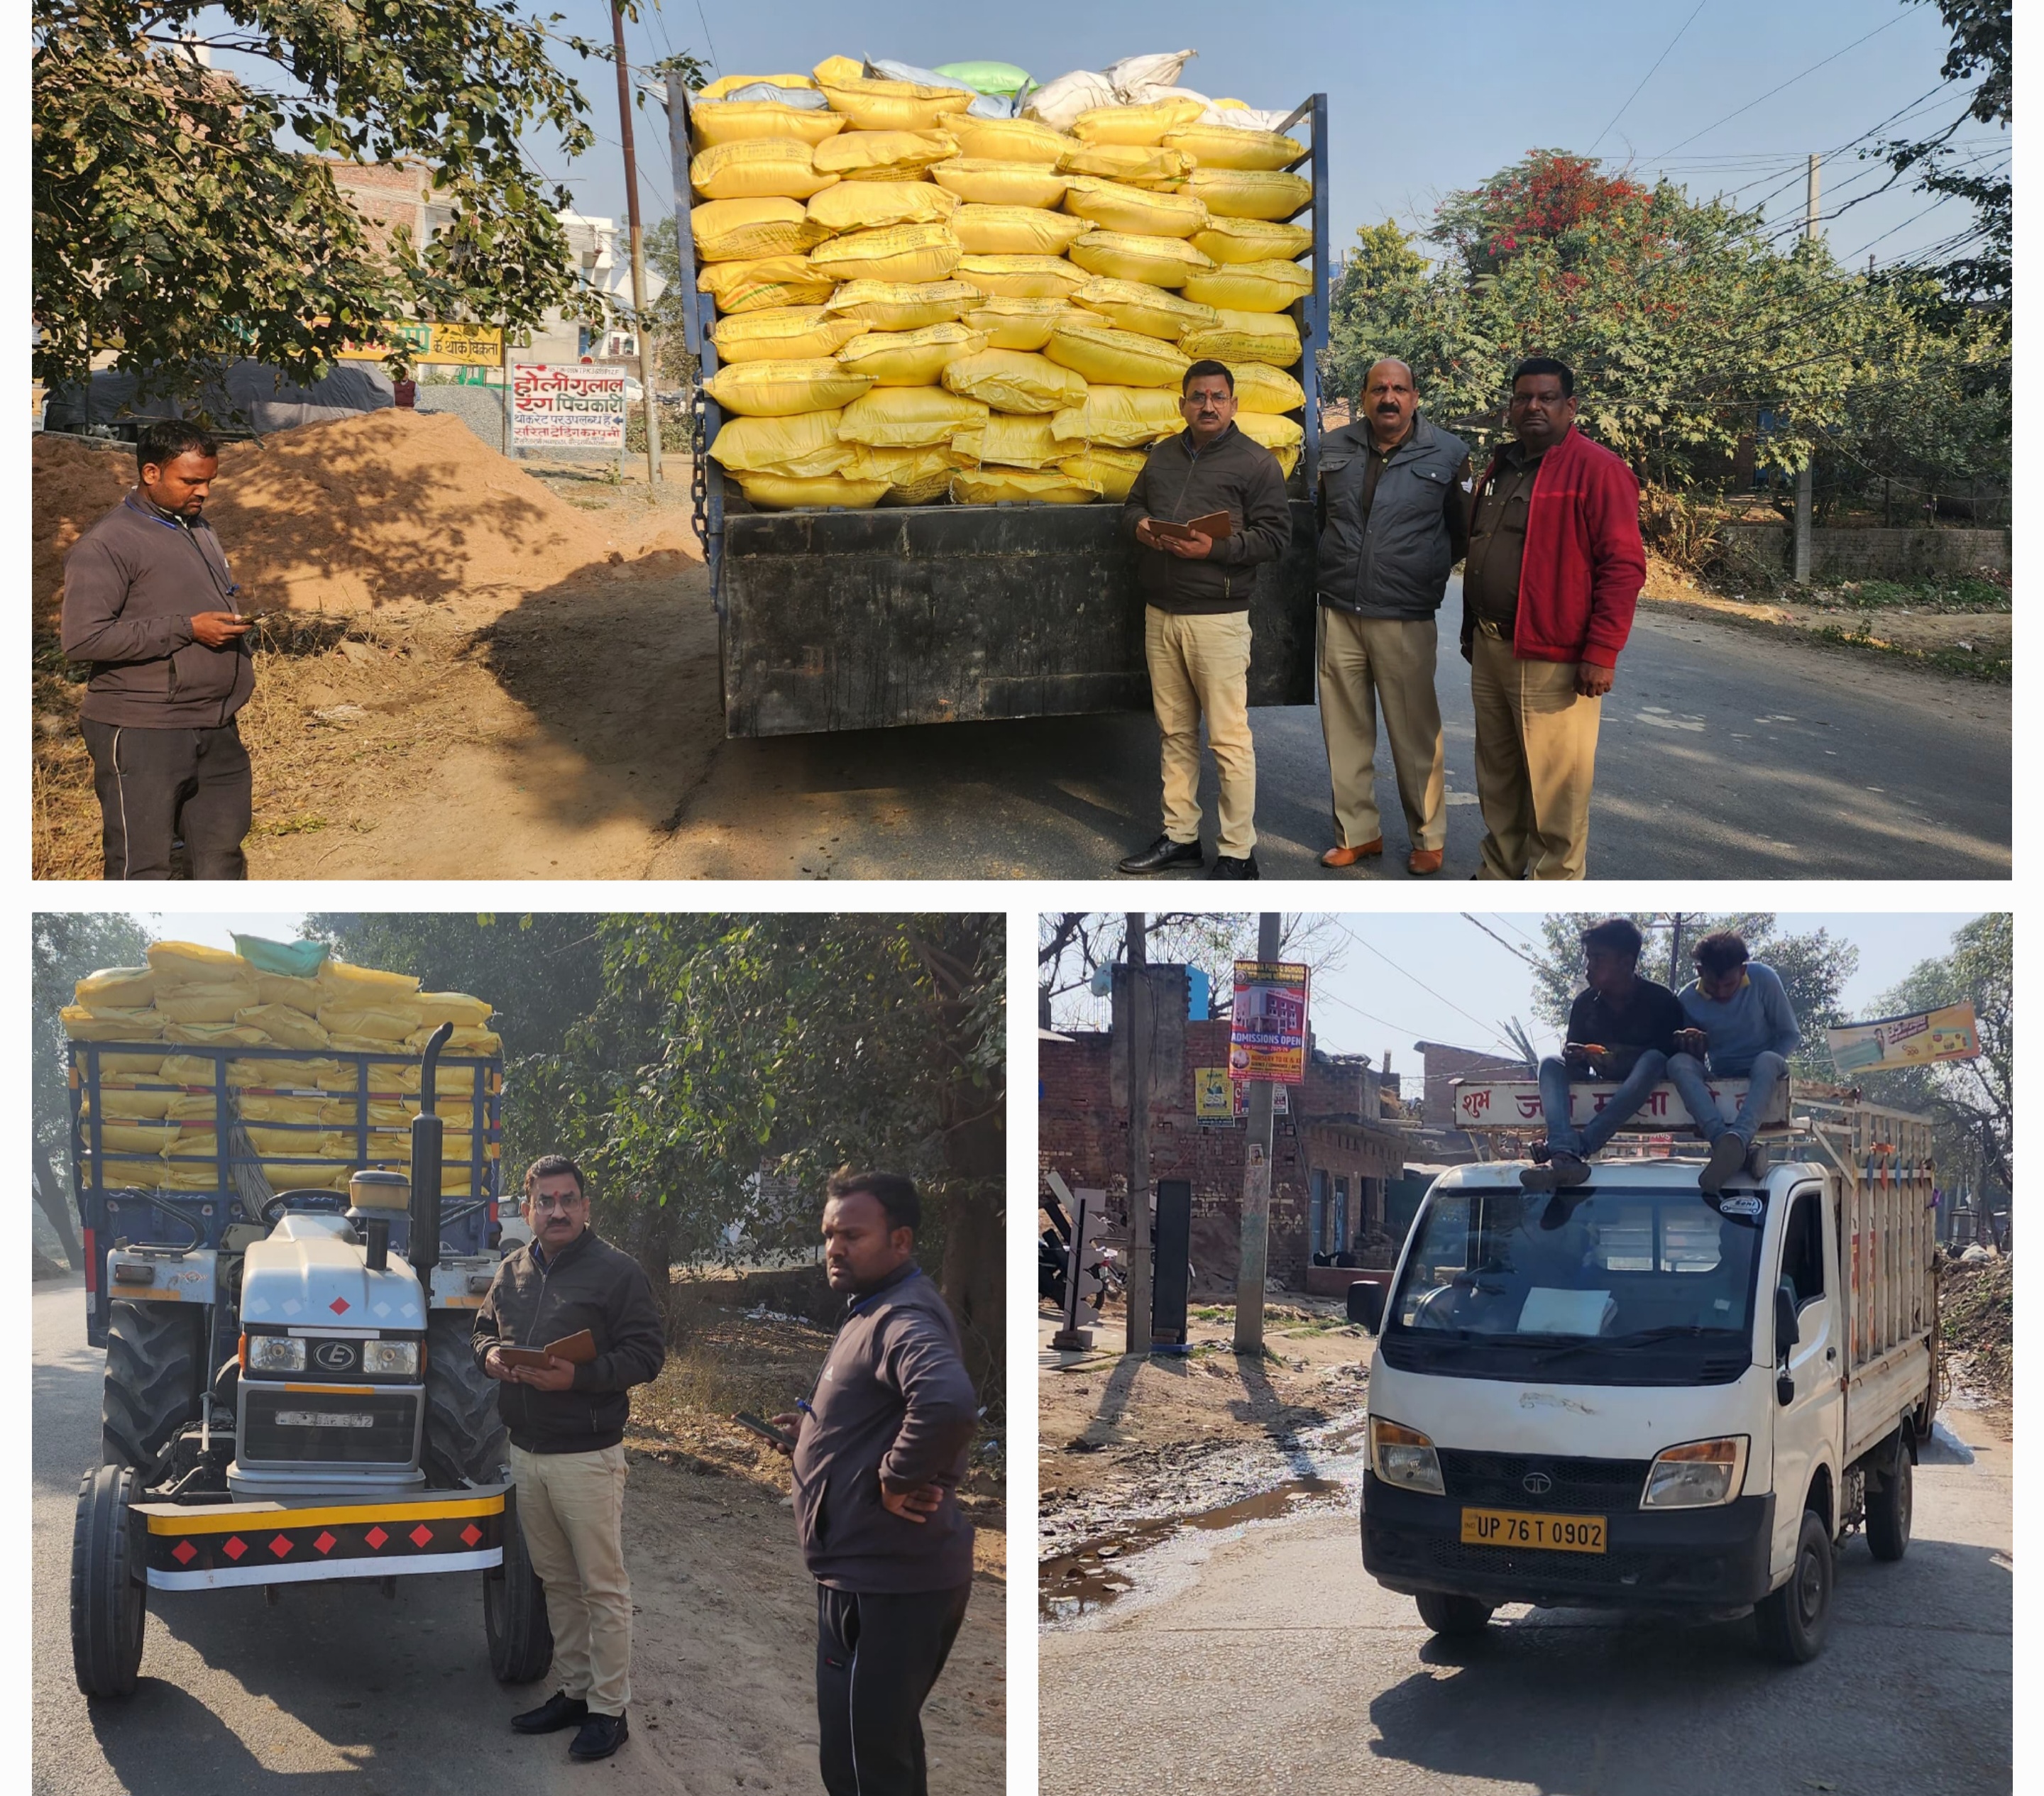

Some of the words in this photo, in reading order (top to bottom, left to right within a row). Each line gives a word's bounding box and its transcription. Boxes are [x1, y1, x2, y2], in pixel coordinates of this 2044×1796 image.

[514, 370, 569, 397] होली
[569, 378, 624, 397] गुलाल
[515, 394, 554, 412] रंग
[556, 393, 624, 413] पिचकारी
[514, 425, 549, 437] सरिता
[581, 426, 621, 438] कम्पनी
[1285, 964, 1304, 974] SCHOOL
[1231, 1032, 1280, 1045] ADMISSIONS
[1280, 1036, 1301, 1046] OPEN
[1462, 1090, 1491, 1118] शुभ
[1478, 1516, 1500, 1538] UP
[1507, 1519, 1529, 1541] 76
[1535, 1521, 1544, 1542] T
[1552, 1522, 1602, 1546] 0902
